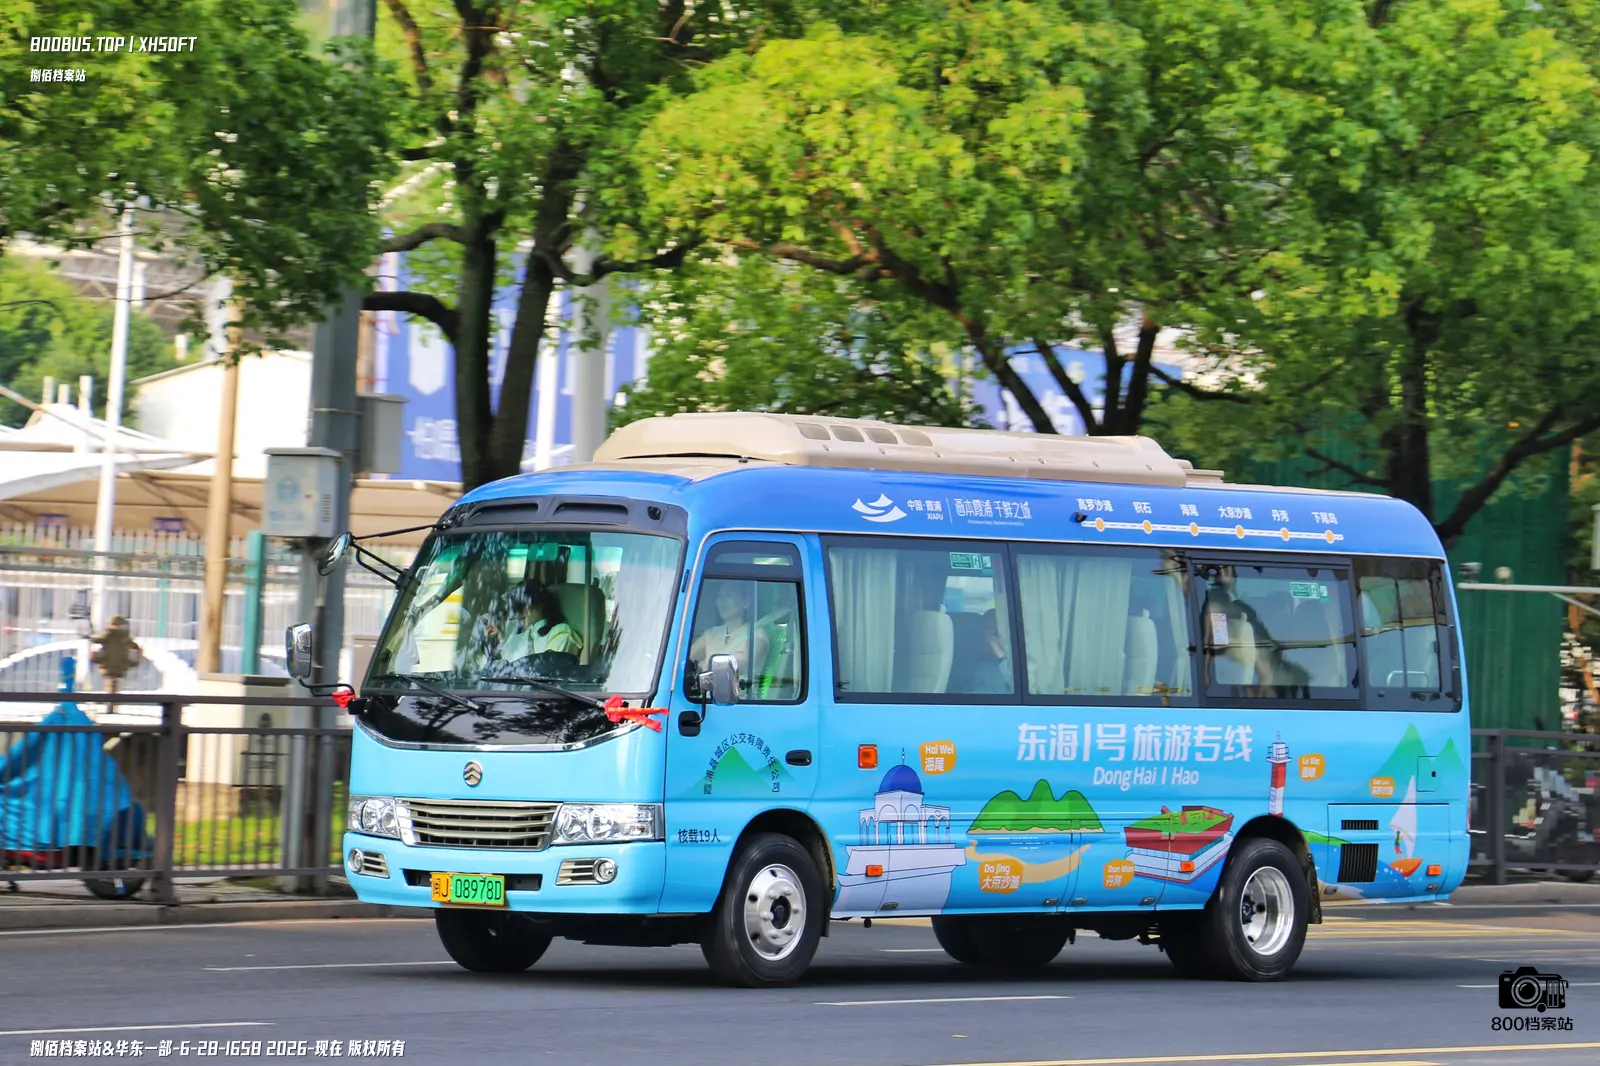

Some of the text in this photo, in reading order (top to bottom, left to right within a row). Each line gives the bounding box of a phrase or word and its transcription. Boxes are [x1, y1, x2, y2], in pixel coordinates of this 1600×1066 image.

[927, 513, 944, 521] XIAPU
[925, 744, 954, 754] Hai Wei
[1132, 723, 1254, 763] 旅游专线
[1171, 767, 1200, 786] Hao
[678, 828, 721, 844] 核载19人
[984, 864, 1011, 875] Da Jing
[981, 875, 1020, 889] 大京沙滩
